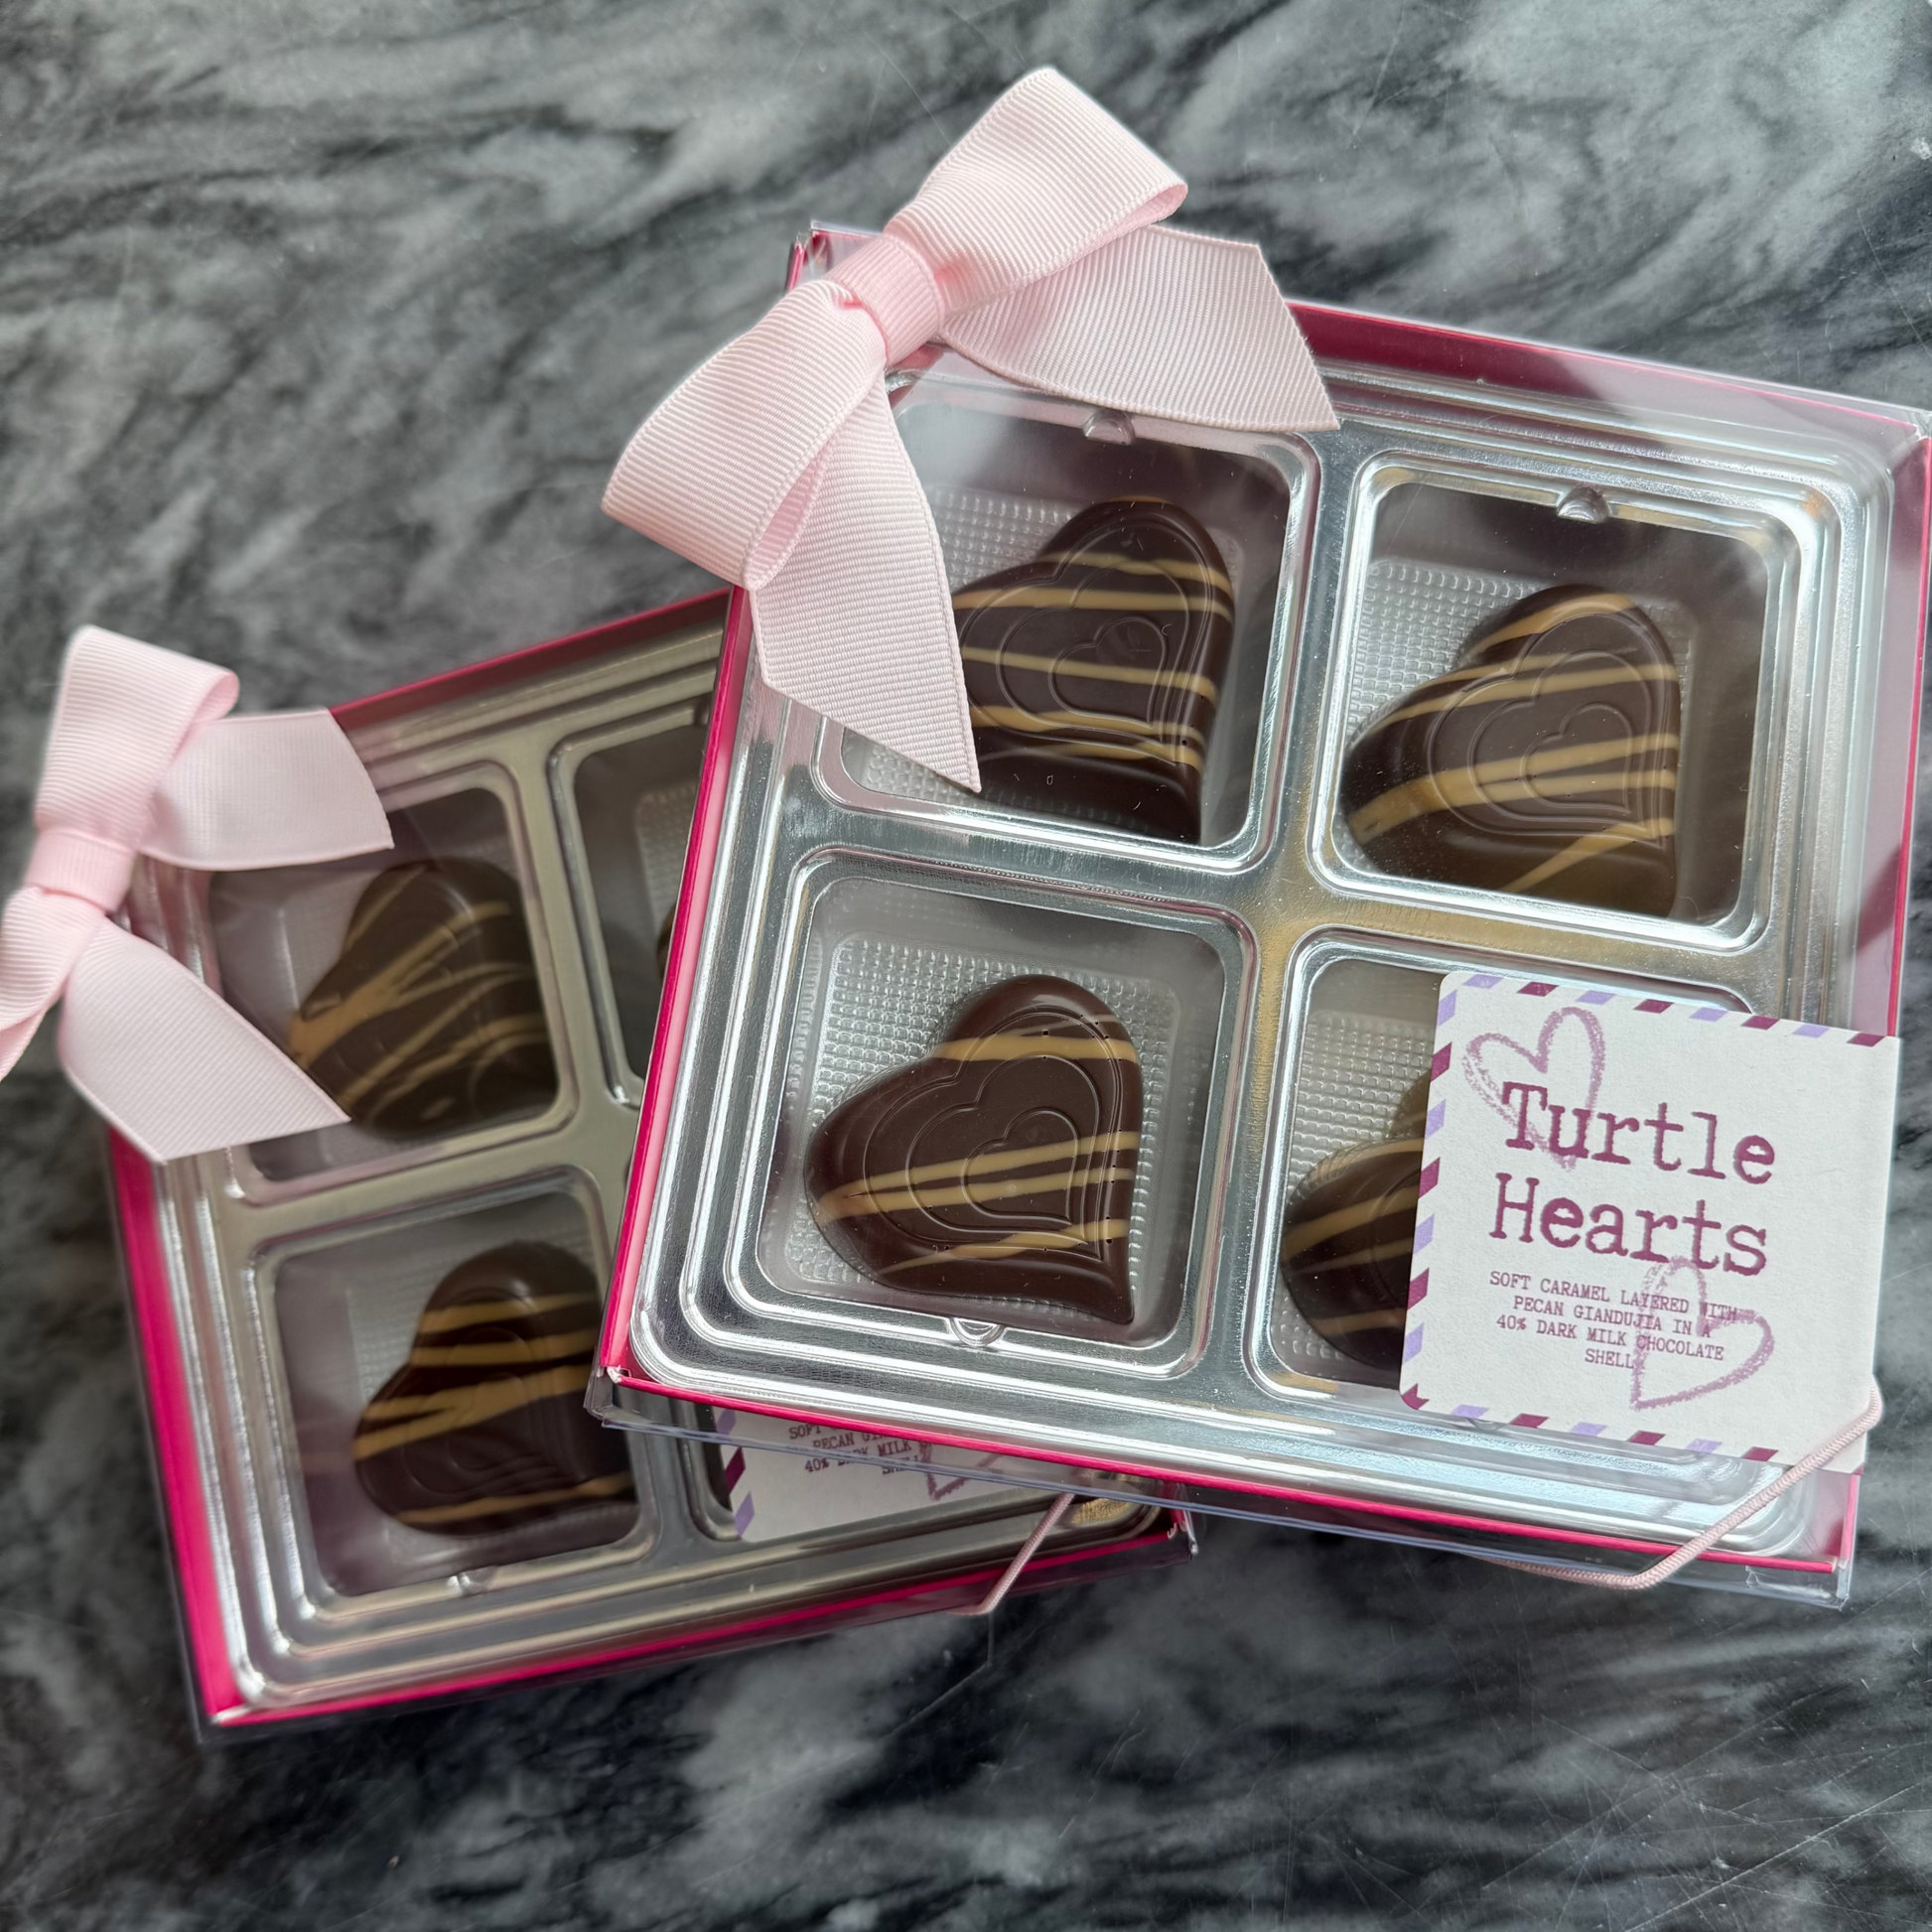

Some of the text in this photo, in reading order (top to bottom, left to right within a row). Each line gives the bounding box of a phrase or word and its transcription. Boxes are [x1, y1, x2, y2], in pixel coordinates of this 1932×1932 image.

[1501, 1080, 1775, 1184] Turtle
[1488, 1172, 1767, 1277] Hearts
[1489, 1270, 1531, 1290] SOFT
[1540, 1278, 1610, 1303] CARAMEL
[1620, 1290, 1690, 1313] LAYERED
[1496, 1313, 1725, 1361] 40% DARK MILK CHOCOLATE
[1512, 1295, 1565, 1316] PECAN
[1672, 1318, 1693, 1335] IN
[1701, 1322, 1712, 1338] A
[1584, 1347, 1635, 1369] SHELL
